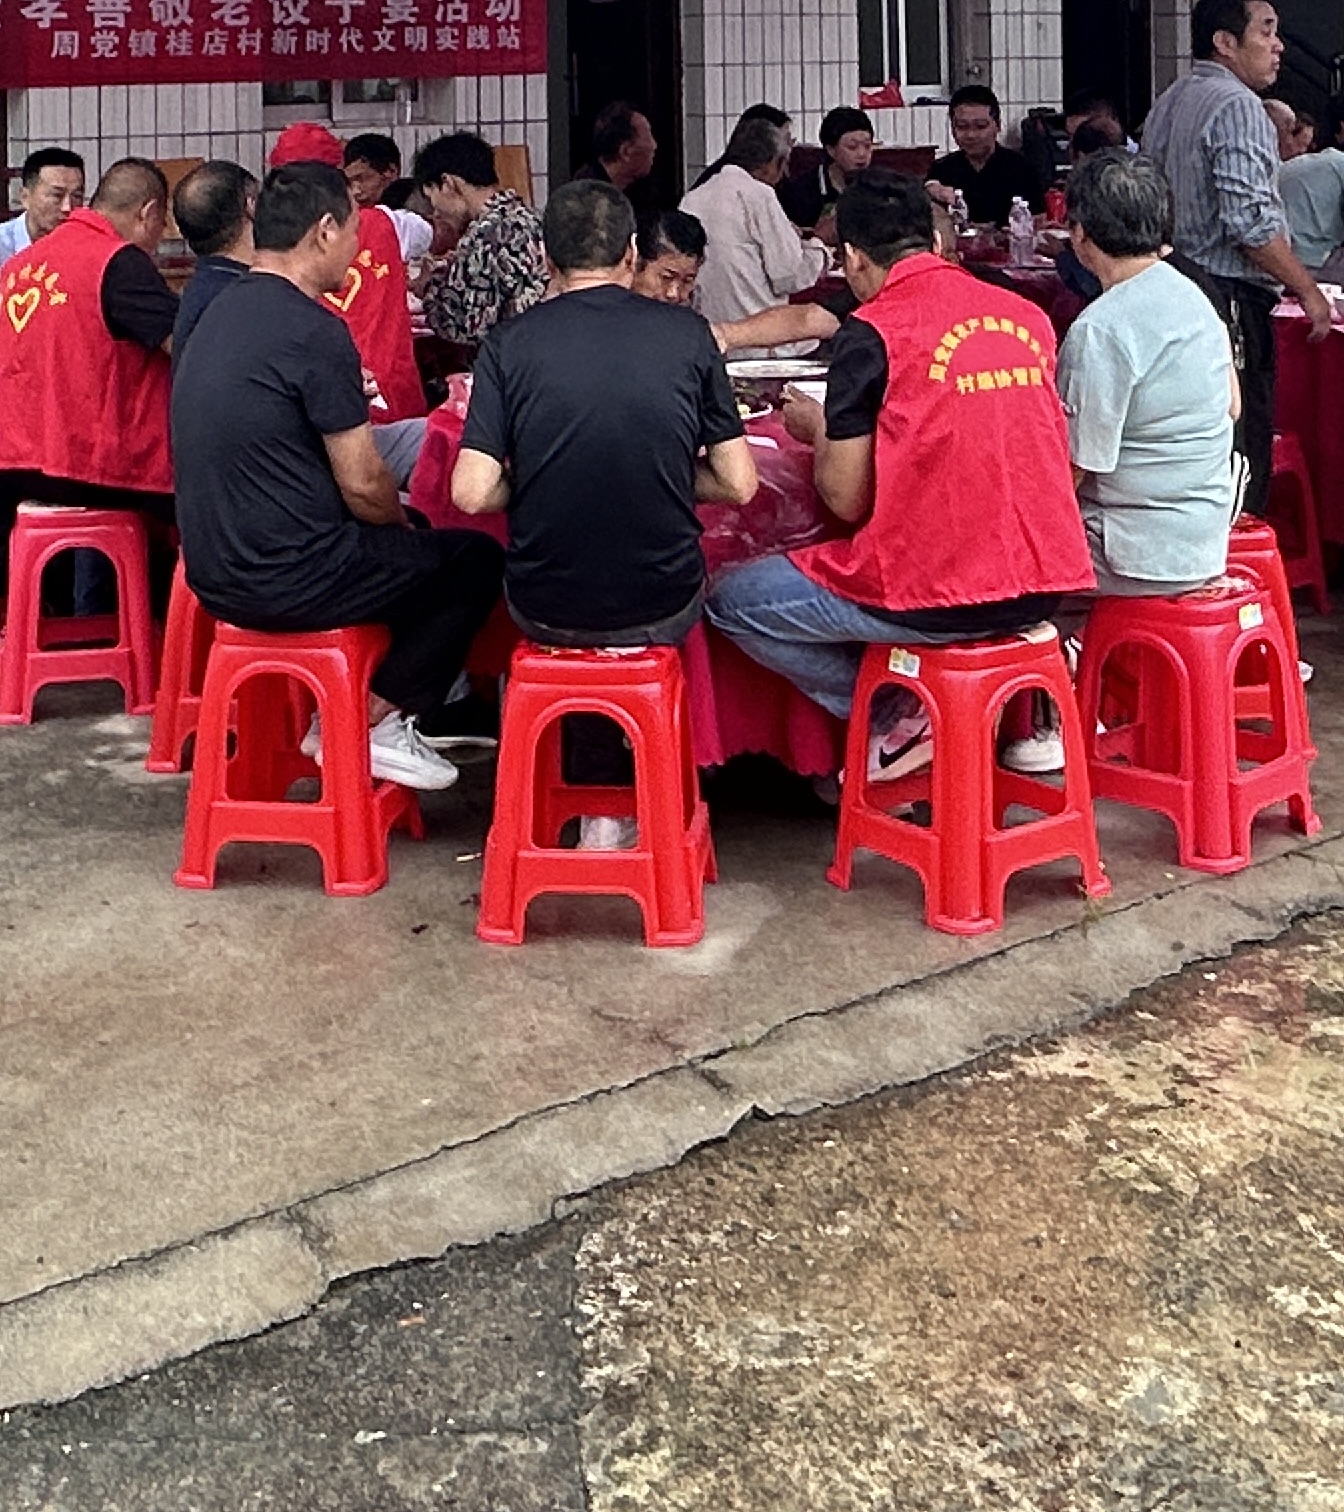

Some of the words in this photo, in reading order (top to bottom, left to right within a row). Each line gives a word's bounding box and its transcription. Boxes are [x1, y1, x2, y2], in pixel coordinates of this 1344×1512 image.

[51, 25, 523, 59] 周党镇桂店村新时代文明实践站
